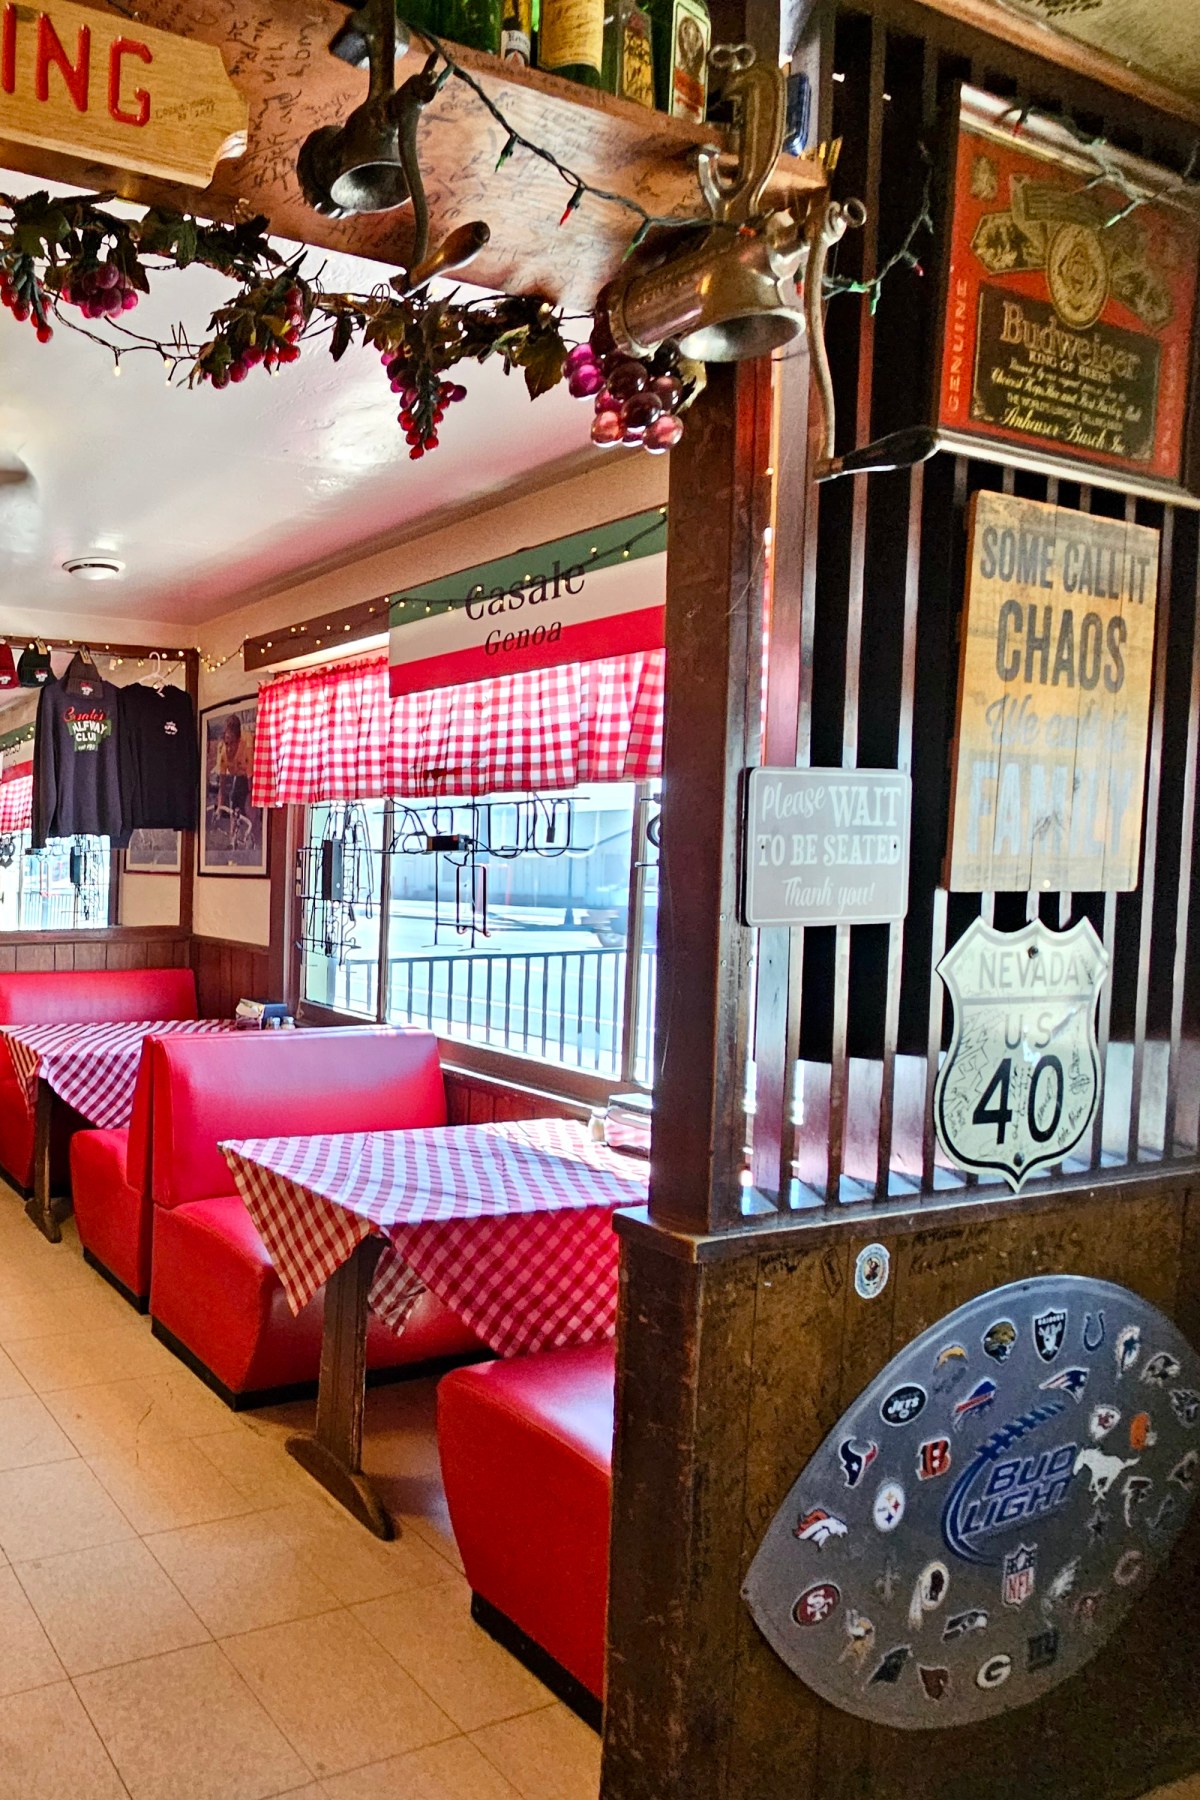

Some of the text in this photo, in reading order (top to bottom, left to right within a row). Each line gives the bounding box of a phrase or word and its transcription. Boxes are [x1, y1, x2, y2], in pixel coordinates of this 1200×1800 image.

[947, 278, 968, 412] GENUINE
[1000, 301, 1141, 380] Budweiser
[465, 560, 585, 620] Casale
[980, 525, 1150, 605] SOME CALL IT
[485, 621, 562, 656] Genoa
[995, 599, 1128, 694] CHAOS
[985, 694, 1041, 745] We
[762, 782, 902, 828] Please WAIT
[967, 760, 1133, 856] FAMILY
[757, 834, 901, 867] TO BE SEATED
[782, 876, 876, 916] Thank you!
[978, 951, 1080, 989] NEVADA
[972, 1054, 1064, 1145] 40
[887, 1395, 920, 1415] JETS
[983, 1444, 1078, 1498] BUD
[960, 1476, 1072, 1535] LIGHT
[977, 1654, 1011, 1689] G
